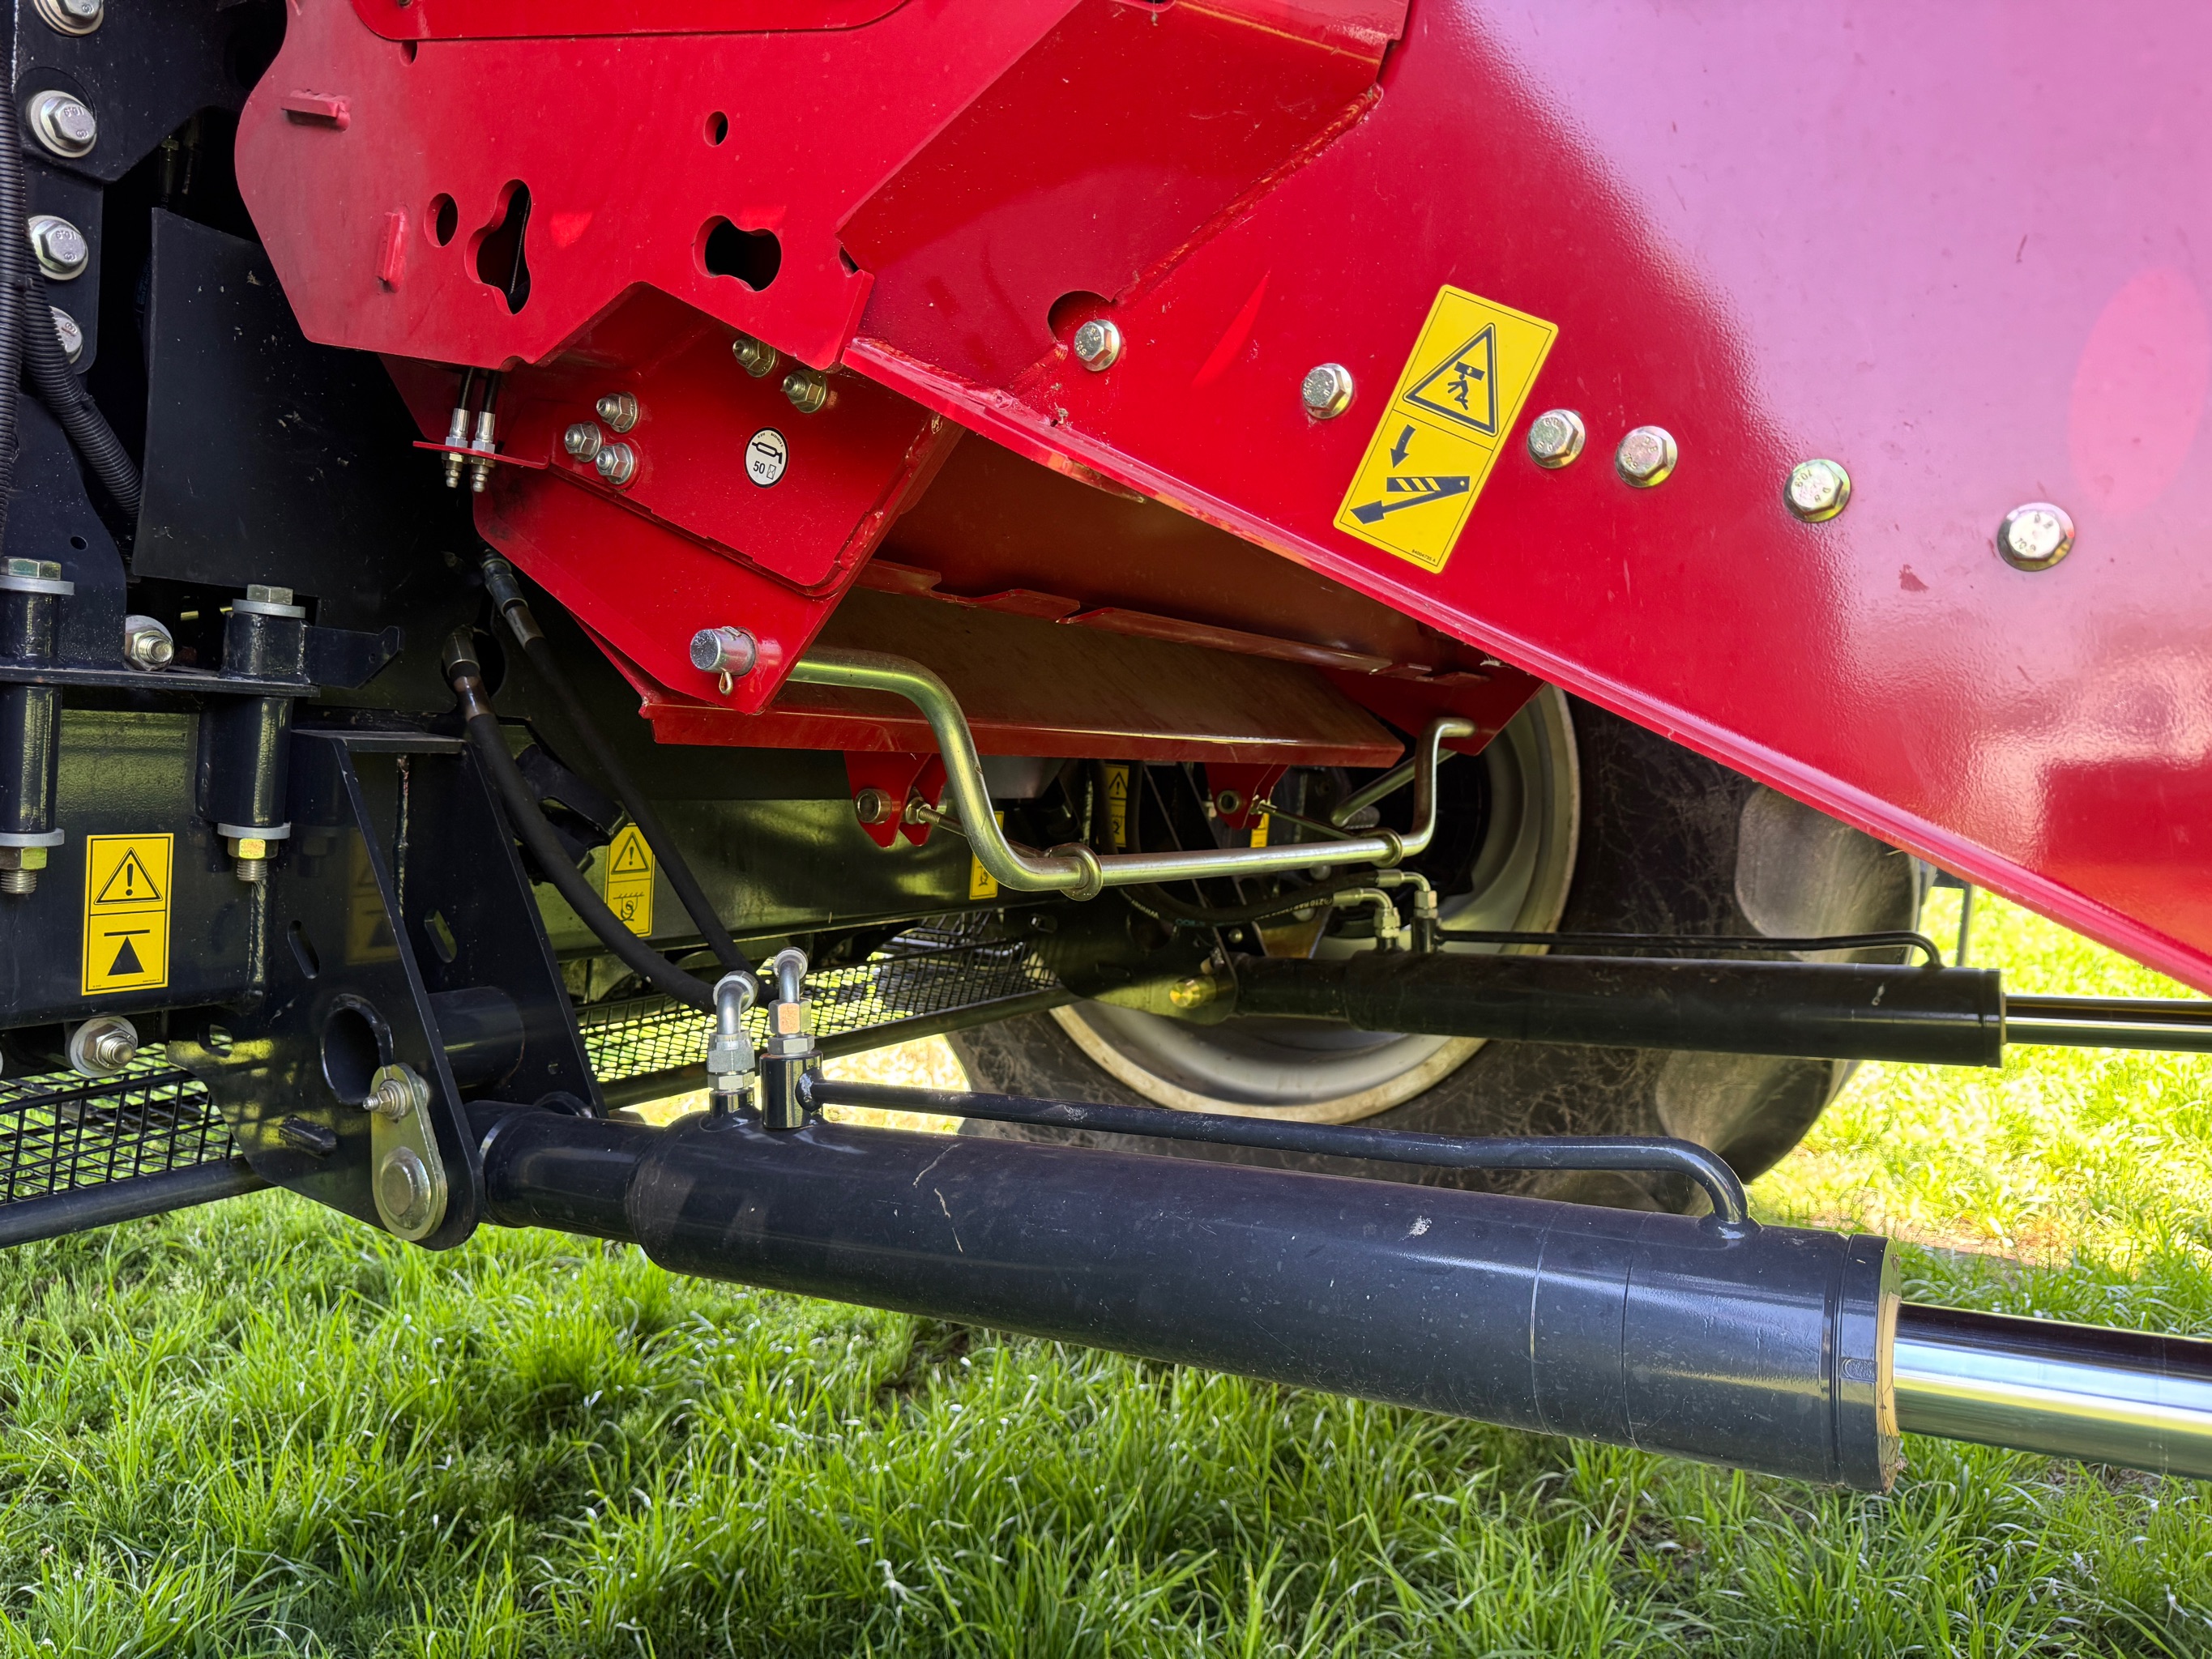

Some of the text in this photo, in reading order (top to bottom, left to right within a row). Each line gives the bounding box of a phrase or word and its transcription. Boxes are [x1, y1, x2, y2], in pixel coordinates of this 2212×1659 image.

[753, 460, 766, 475] 50
[1794, 468, 1813, 487] 10.9
[2014, 536, 2037, 554] 10.9
